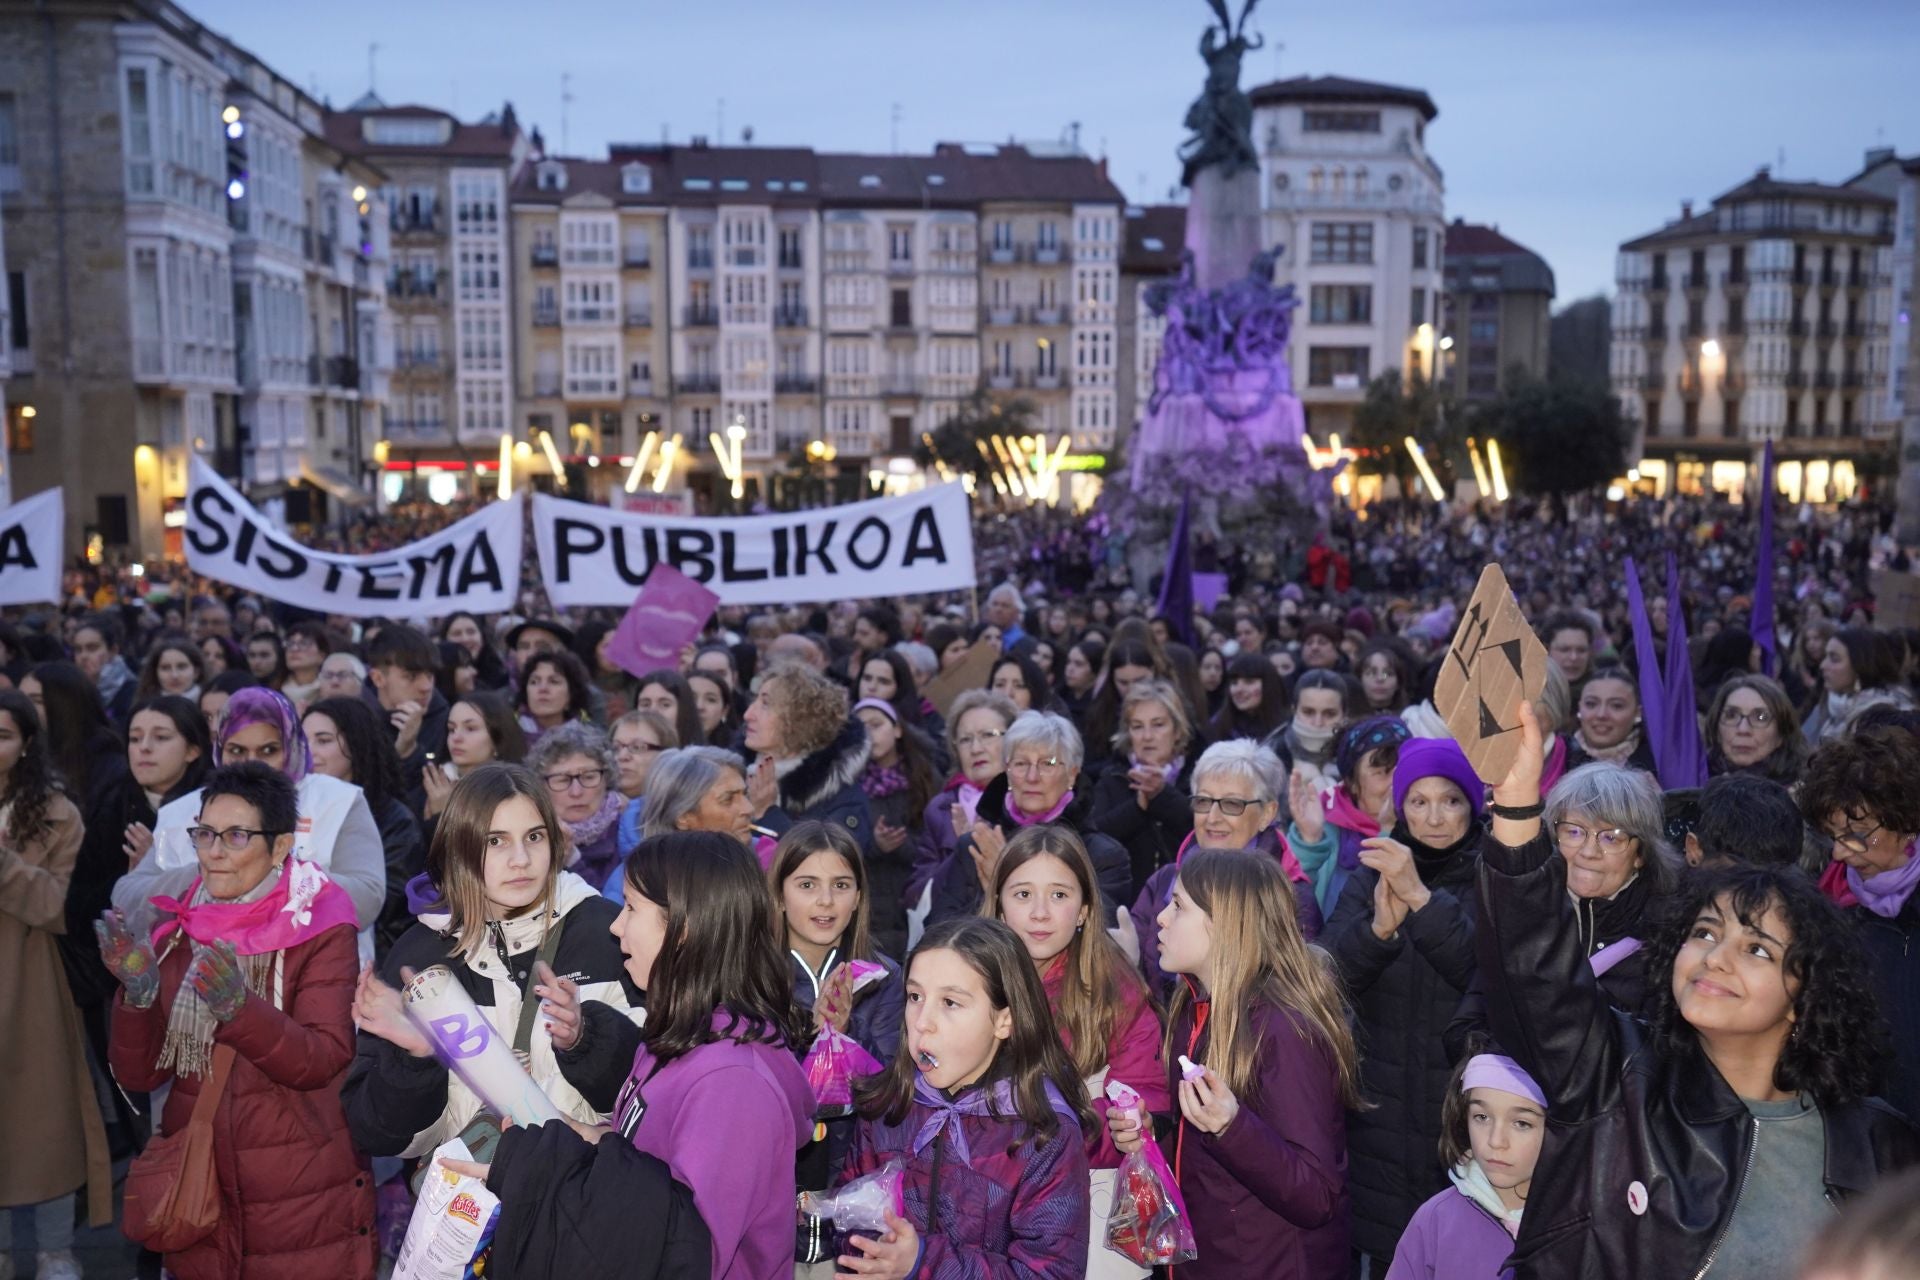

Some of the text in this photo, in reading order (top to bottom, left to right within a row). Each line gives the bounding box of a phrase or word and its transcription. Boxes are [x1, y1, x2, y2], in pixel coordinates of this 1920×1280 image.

[185, 486, 503, 599] SISTEMA
[554, 505, 948, 587] PUBLIKOA
[451, 1194, 481, 1220] Ruffles
